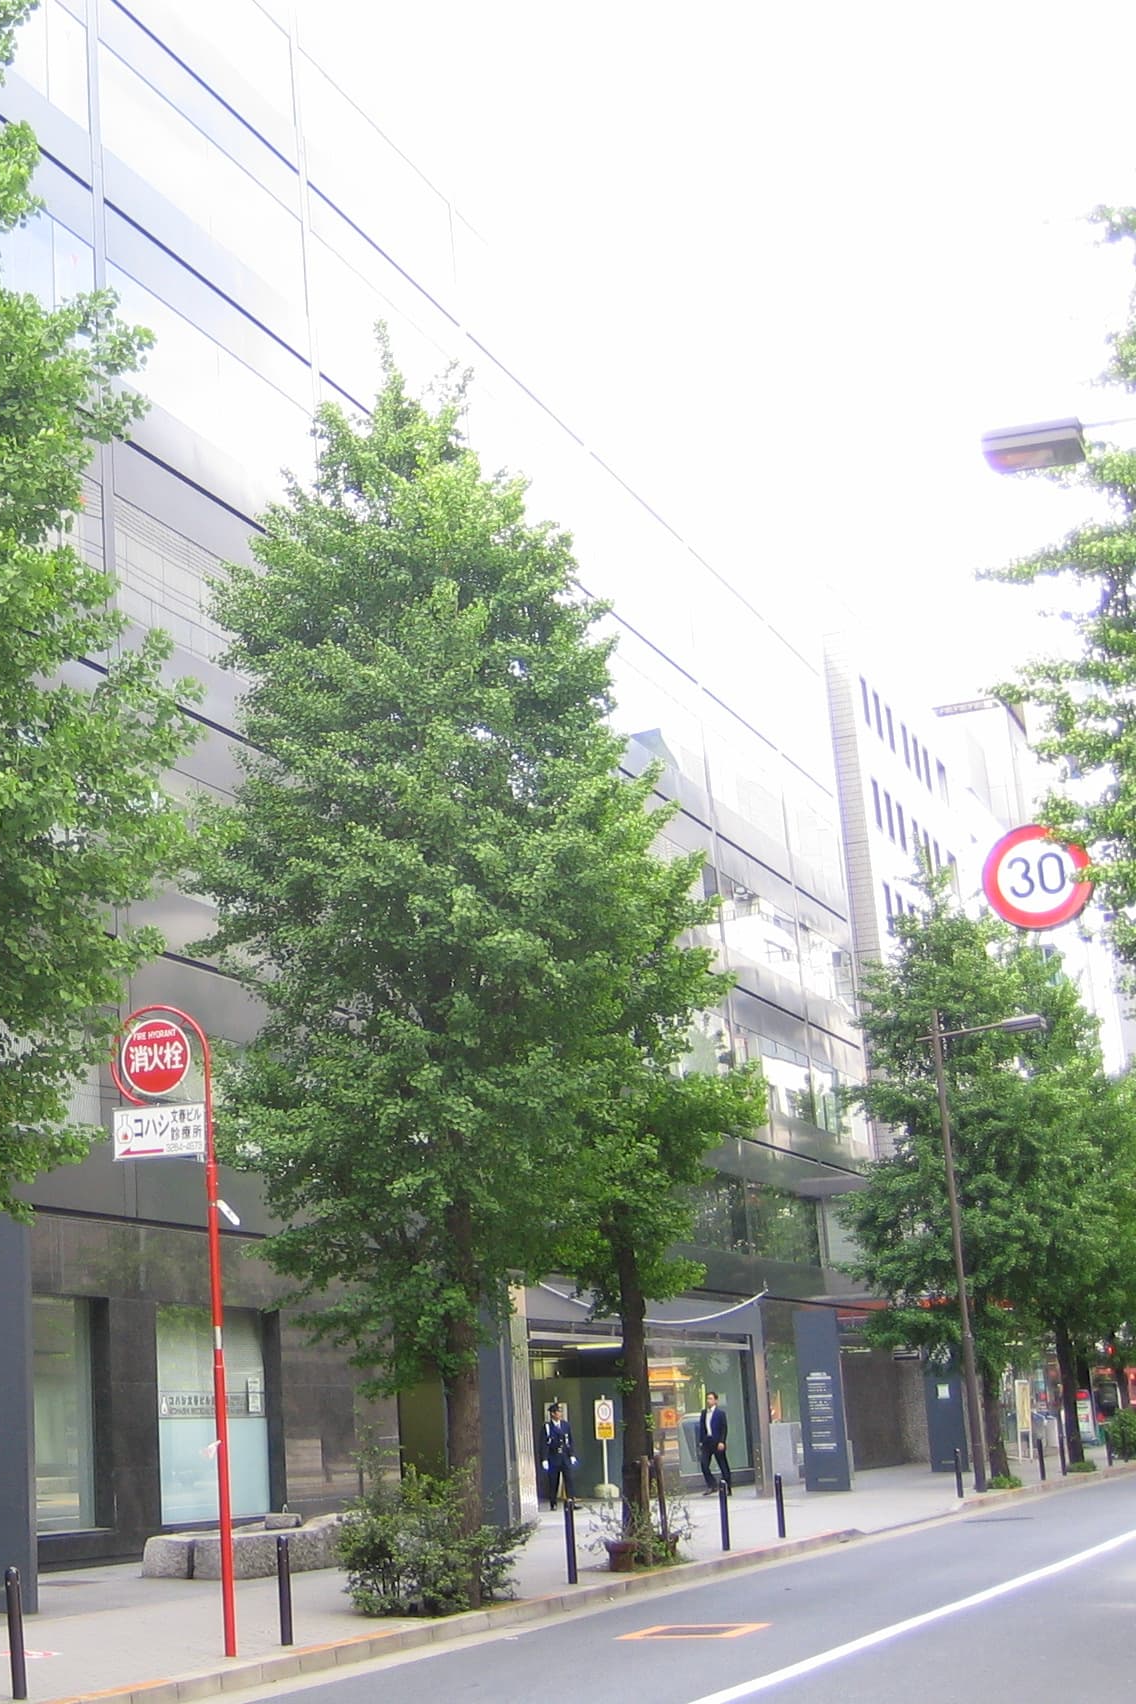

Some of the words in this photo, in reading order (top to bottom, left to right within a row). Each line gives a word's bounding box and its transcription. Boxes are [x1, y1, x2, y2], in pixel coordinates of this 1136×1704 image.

[1007, 851, 1066, 898] 30
[133, 1031, 147, 1041] FIRE
[147, 1029, 176, 1040] HYDRANT
[129, 1041, 184, 1074] 消火栓
[170, 1107, 202, 1123] 文春ビル
[134, 1114, 170, 1138] コハシ
[170, 1124, 202, 1141] 診療所
